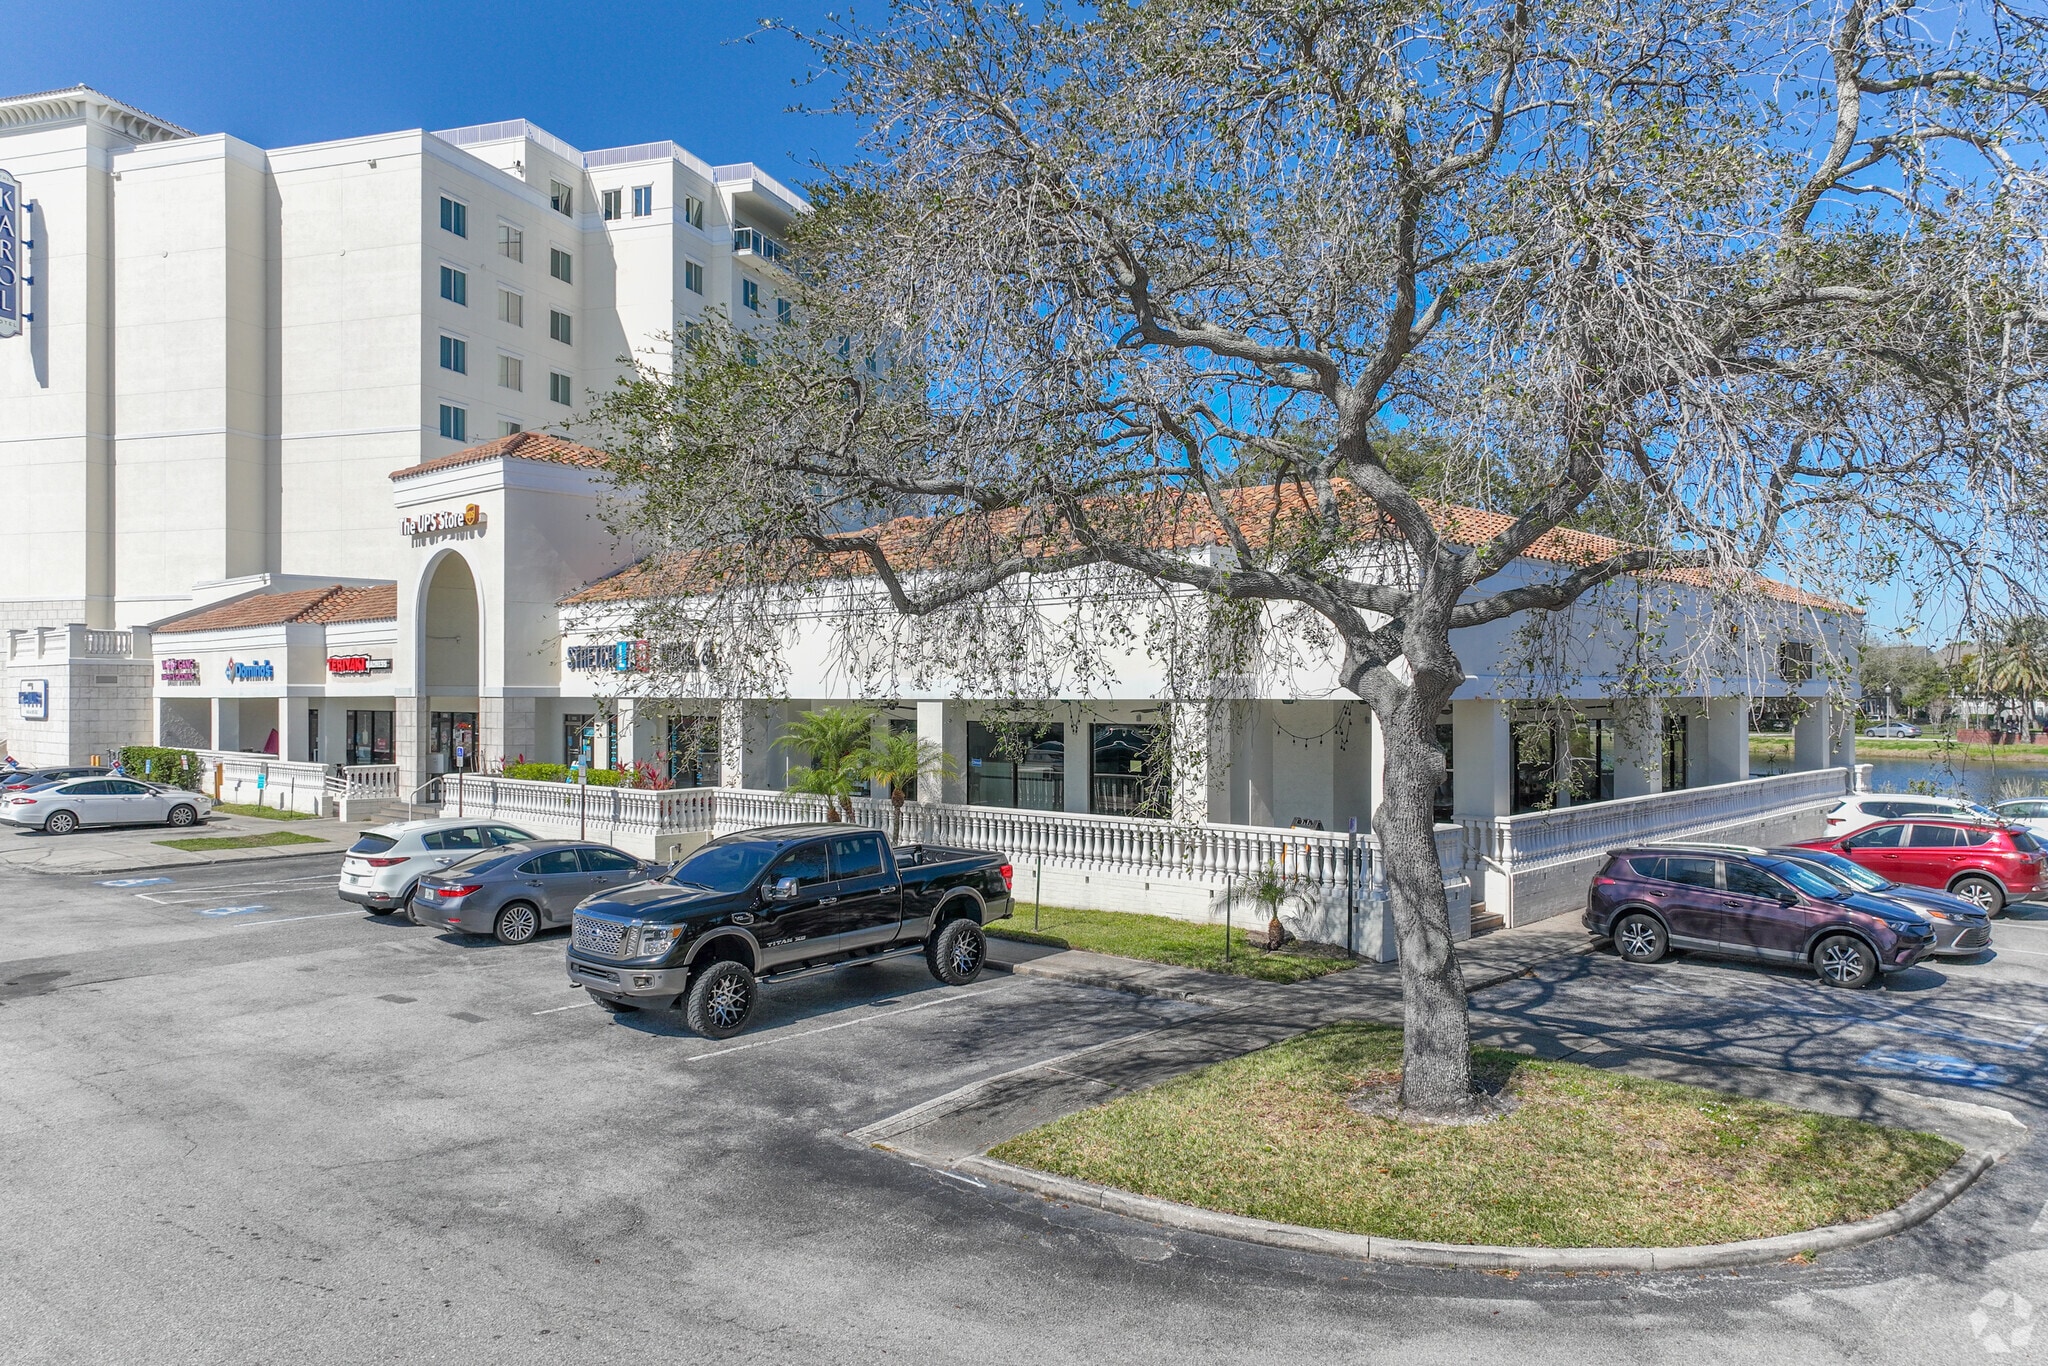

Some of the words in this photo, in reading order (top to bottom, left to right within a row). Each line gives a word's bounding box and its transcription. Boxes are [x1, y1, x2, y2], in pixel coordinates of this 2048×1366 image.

[0, 187, 17, 312] KAROL
[400, 517, 416, 536] The
[417, 512, 437, 533] UPS
[438, 510, 464, 530] Store
[235, 660, 274, 678] Domino's
[327, 657, 367, 672] TERIYAKI
[766, 937, 793, 948] TITAN
